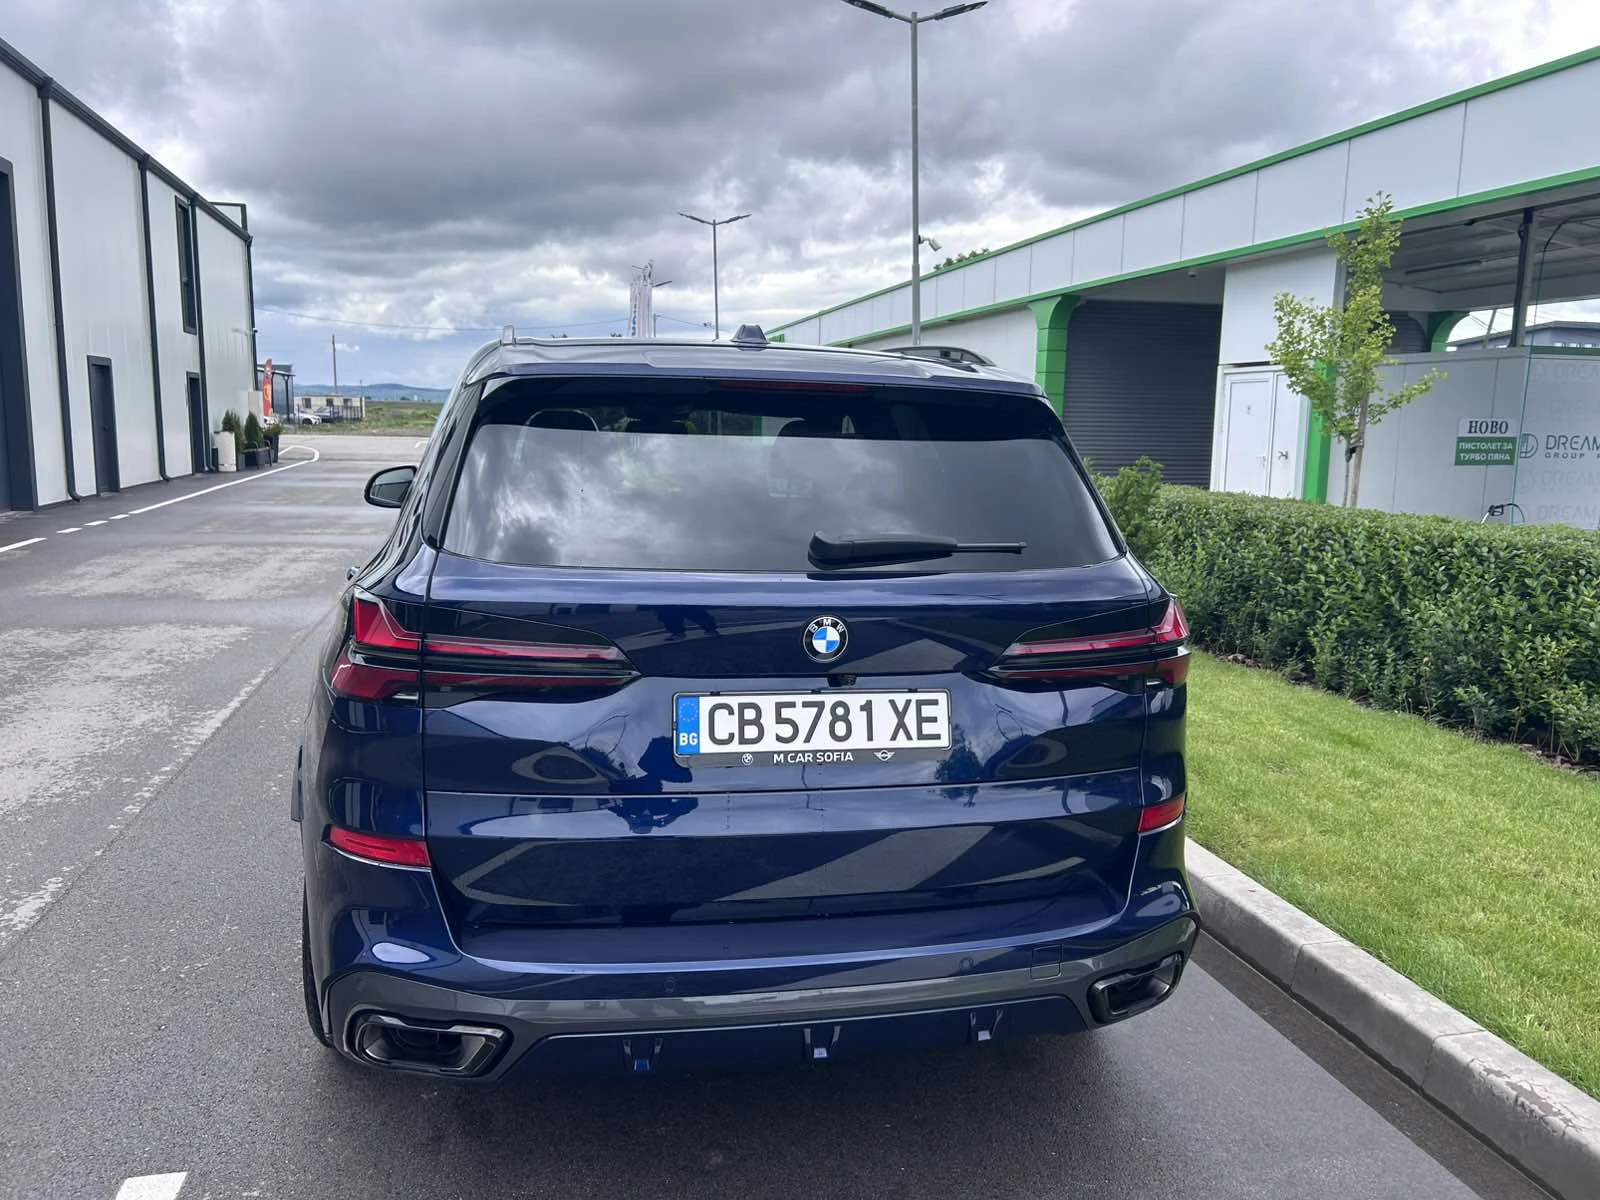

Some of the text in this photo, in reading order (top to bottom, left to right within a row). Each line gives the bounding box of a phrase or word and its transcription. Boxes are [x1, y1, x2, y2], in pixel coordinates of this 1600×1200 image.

[1468, 420, 1509, 434] НОВО
[1459, 442, 1513, 450] ПИСТОЛЕТ ЗА
[1460, 453, 1511, 461] ТУРБО ПЯНА
[1544, 451, 1585, 460] GROUP
[808, 618, 846, 633] BMW
[679, 698, 942, 746] BG CB 5781 XE
[773, 751, 854, 764] M CAR SOFIA
